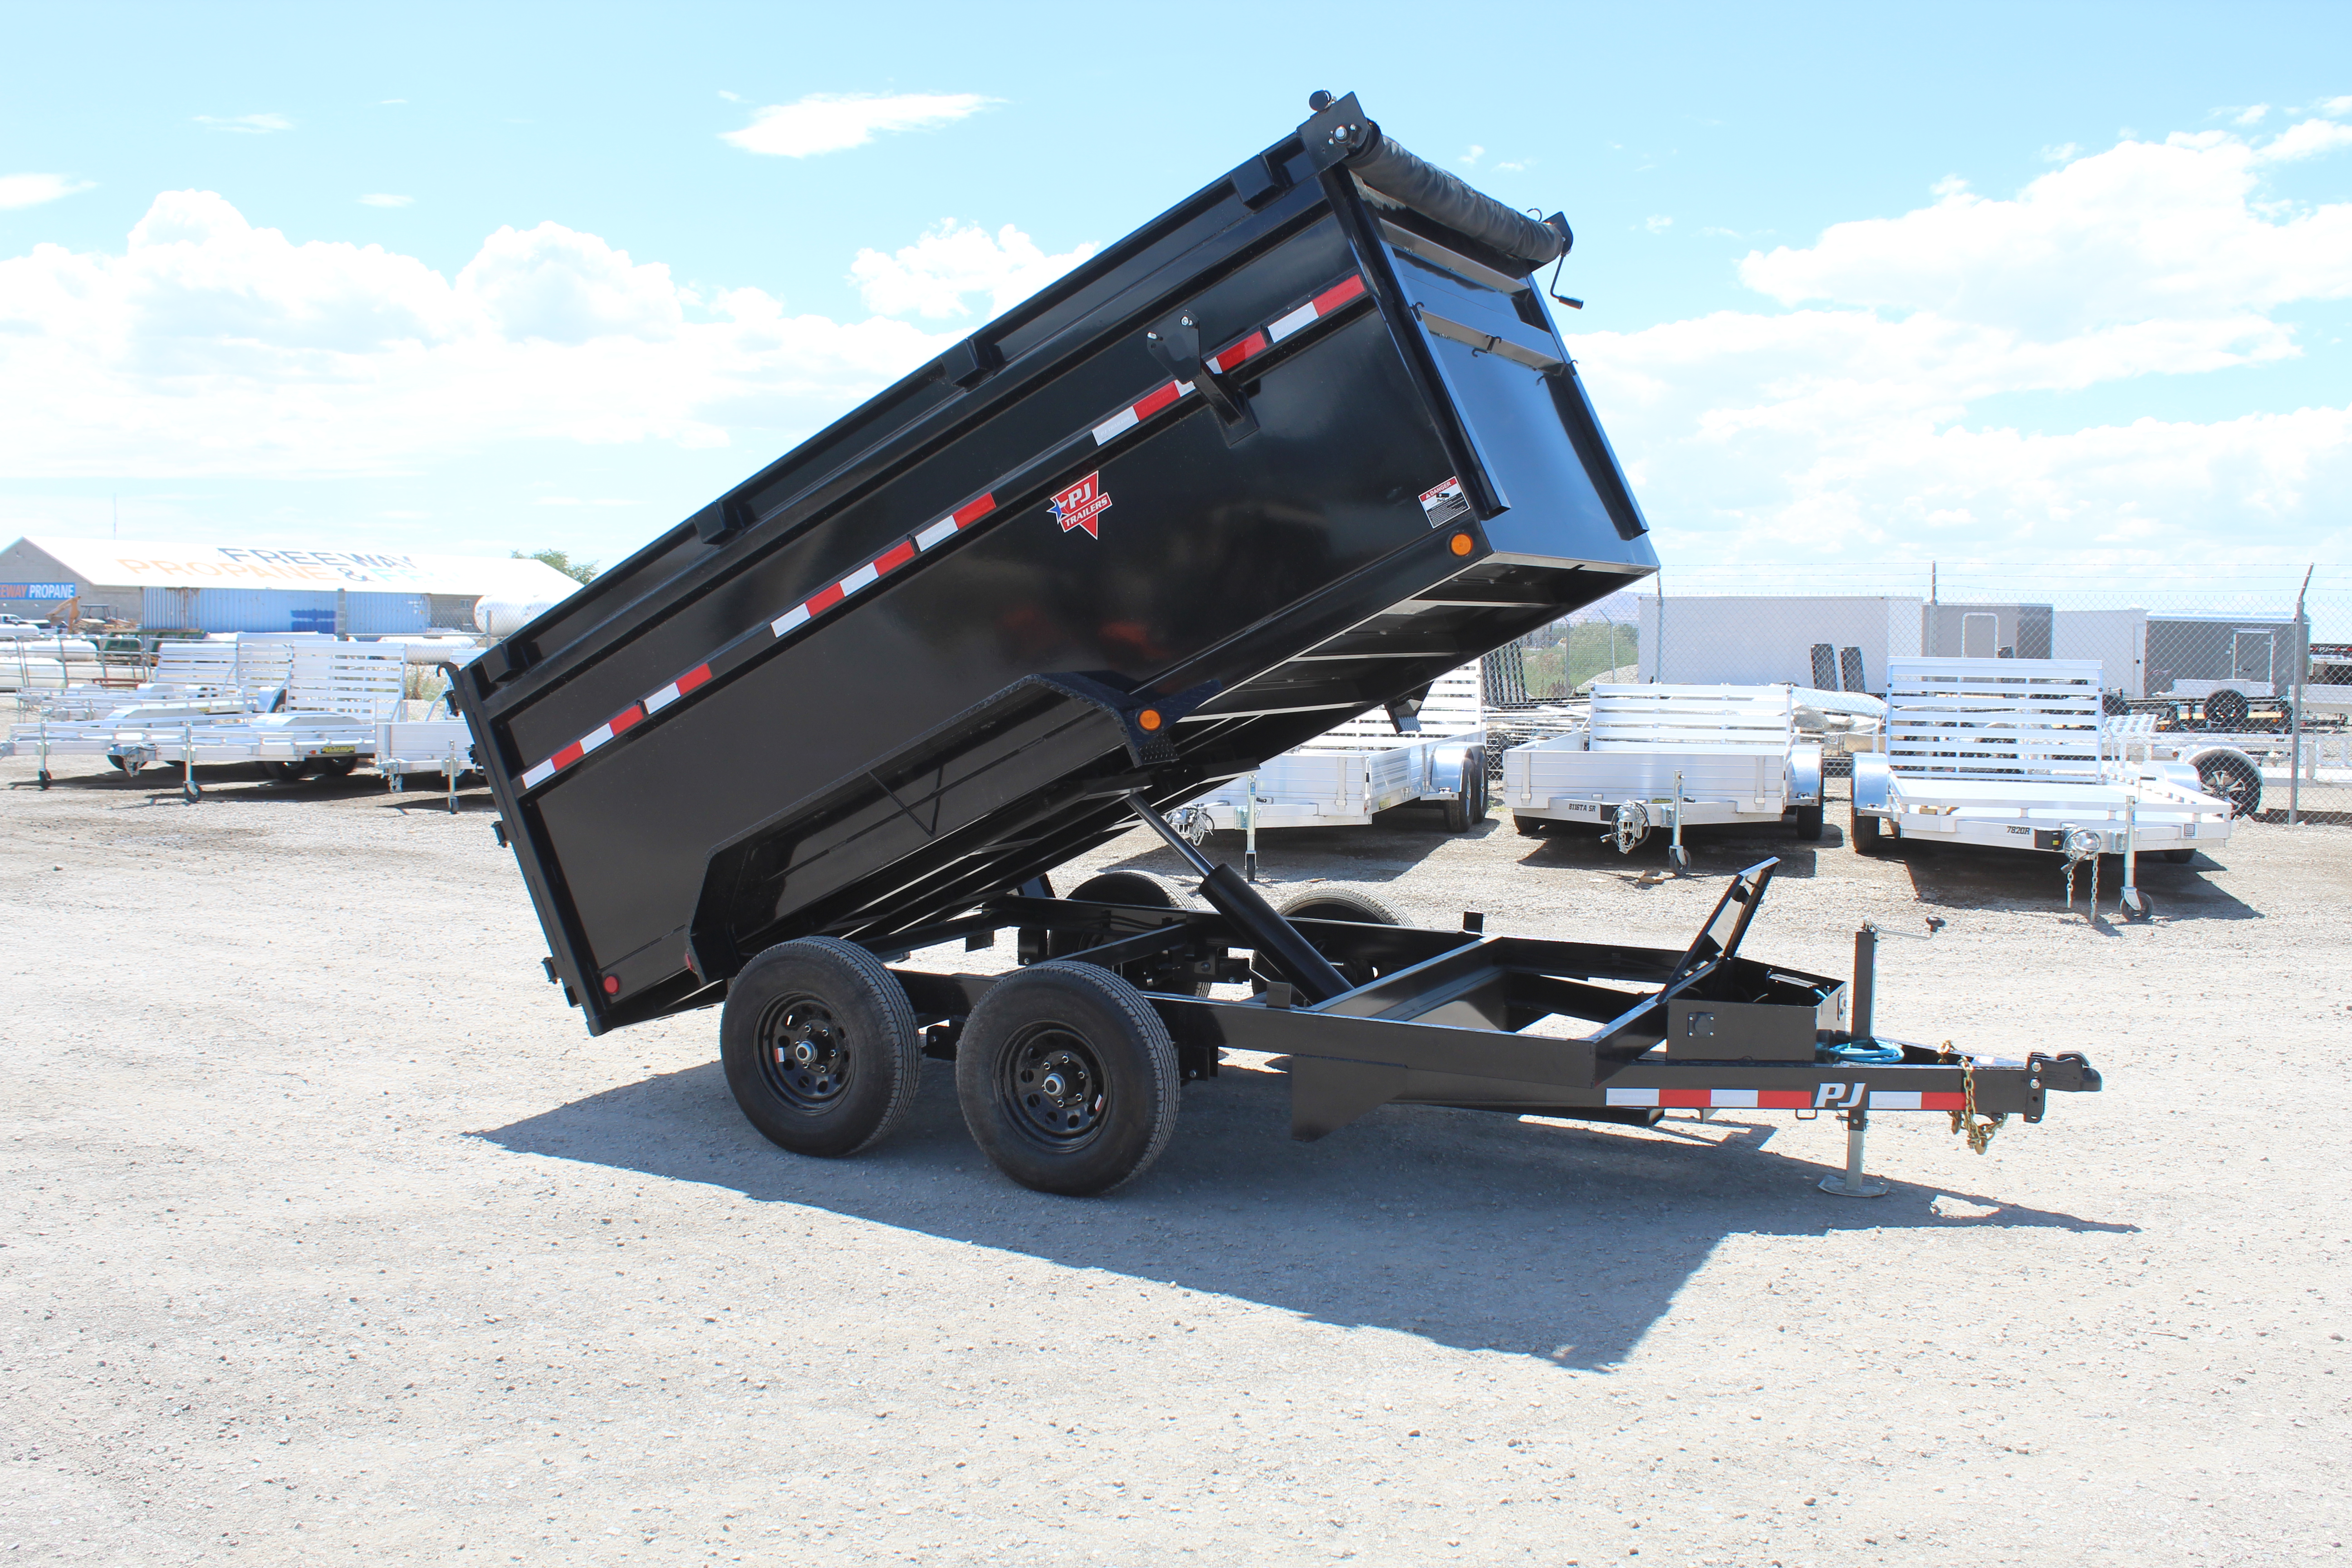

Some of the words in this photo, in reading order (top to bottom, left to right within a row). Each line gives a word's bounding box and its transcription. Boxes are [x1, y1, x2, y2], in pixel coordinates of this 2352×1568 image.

[1108, 416, 1130, 431] TRAILERS
[1068, 482, 1091, 510] PJ
[1430, 481, 1451, 496] DANGER
[1065, 497, 1108, 527] TRAILERS
[216, 548, 418, 568] FREEWAY
[114, 559, 341, 581] PROPANE
[337, 568, 376, 582] &
[29, 584, 74, 598] PROPANE
[2006, 826, 2030, 834] 7820R
[1814, 1083, 1866, 1107] PJ
